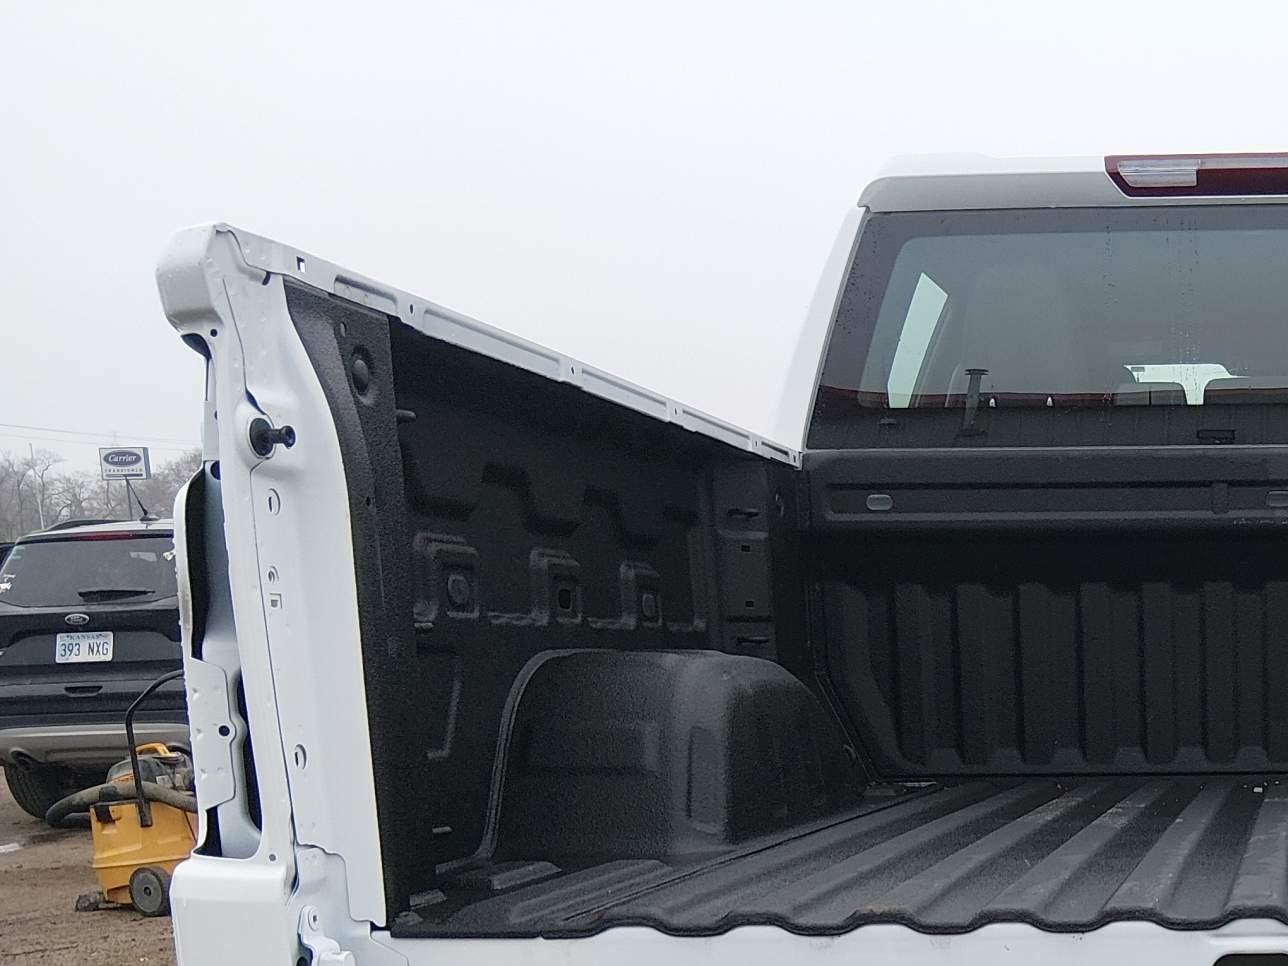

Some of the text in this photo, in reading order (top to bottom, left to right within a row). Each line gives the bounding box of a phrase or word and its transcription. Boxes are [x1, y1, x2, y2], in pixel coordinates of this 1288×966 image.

[108, 454, 137, 462] Carrier
[60, 641, 109, 657] 393 NXG
